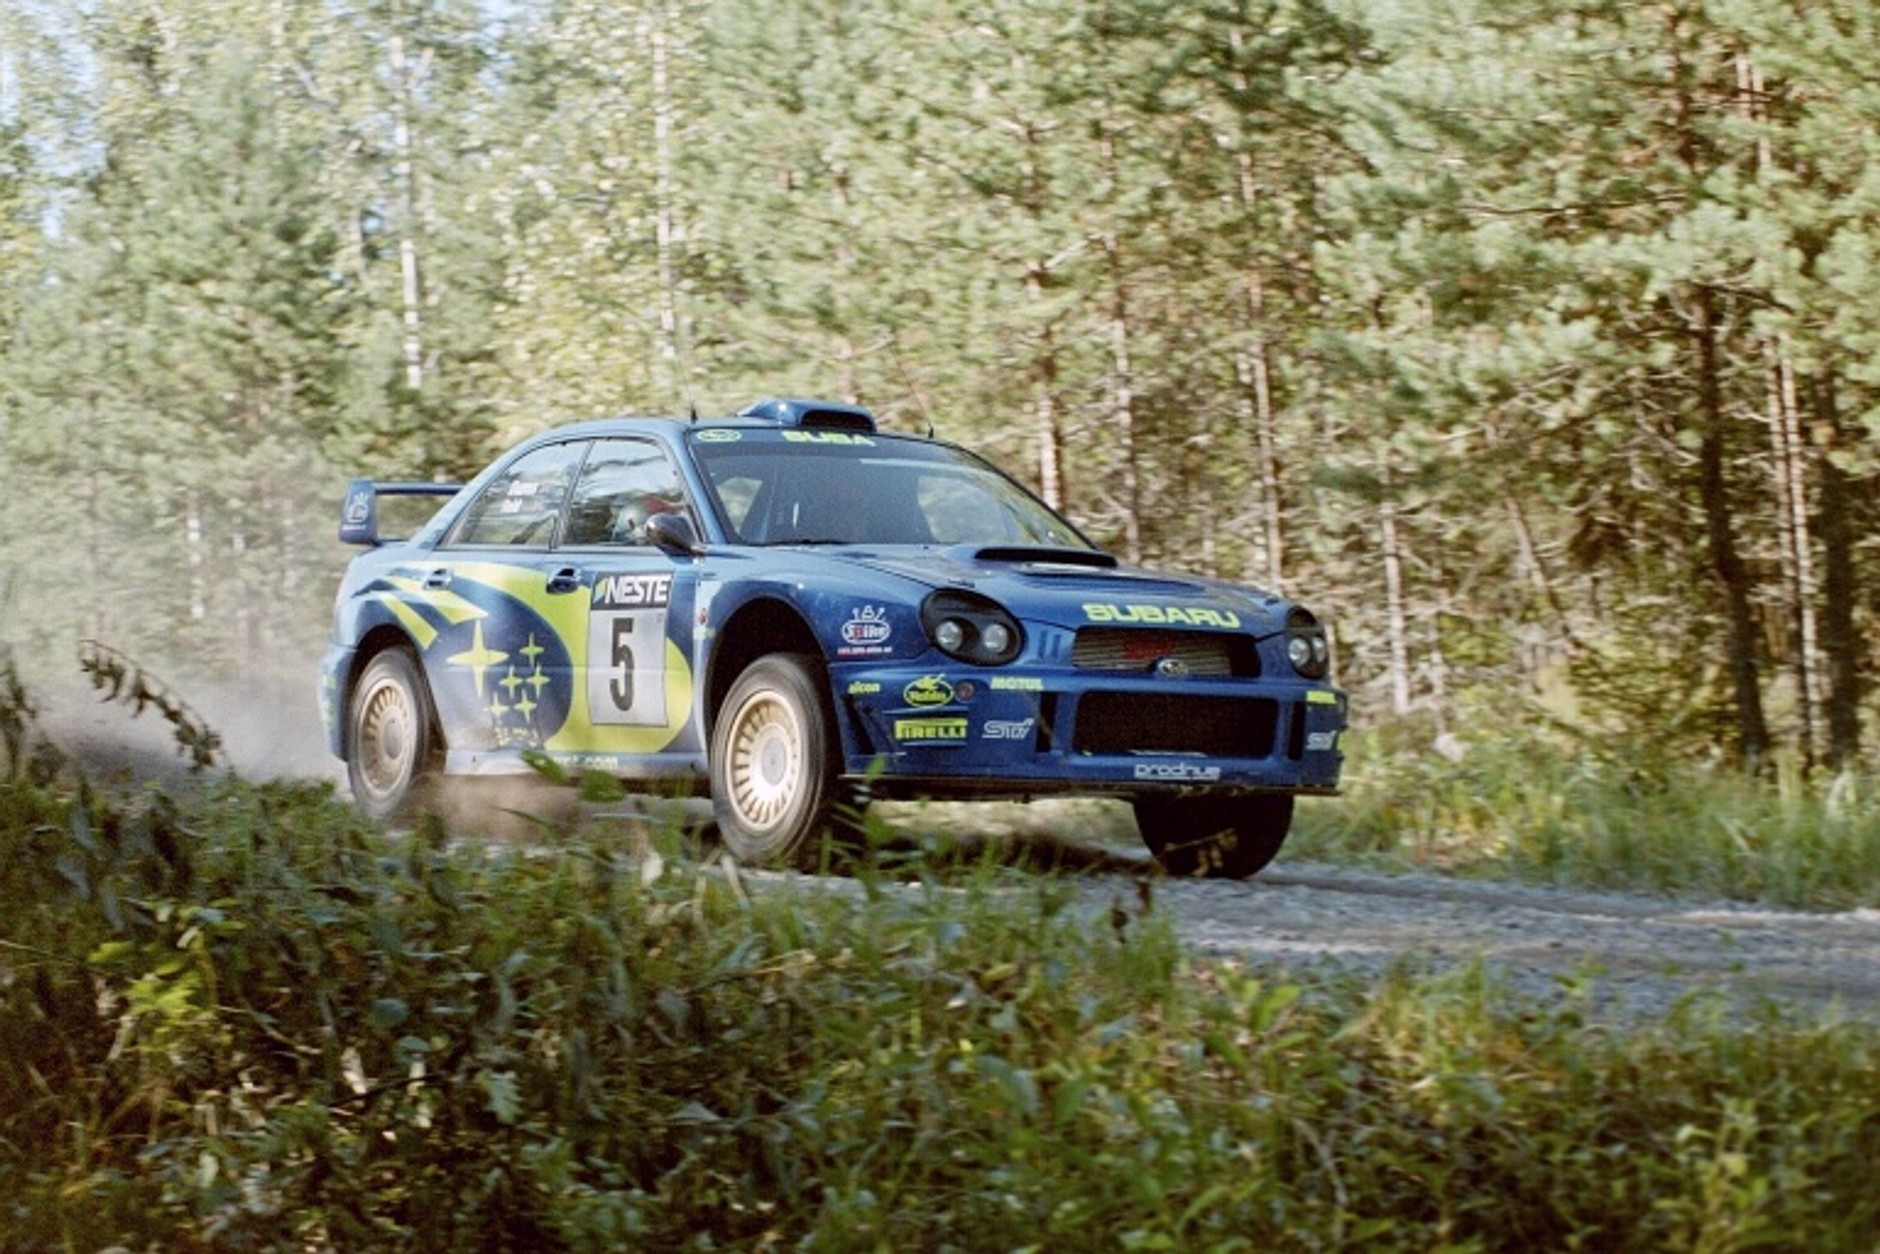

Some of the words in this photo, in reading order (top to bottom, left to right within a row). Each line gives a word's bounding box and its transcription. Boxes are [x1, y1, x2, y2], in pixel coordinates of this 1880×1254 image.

[605, 573, 671, 604] NESTE
[1082, 602, 1241, 629] SUBARU
[610, 617, 635, 711] 5
[990, 676, 1044, 691] MOTUL
[895, 718, 968, 740] PIRELLI
